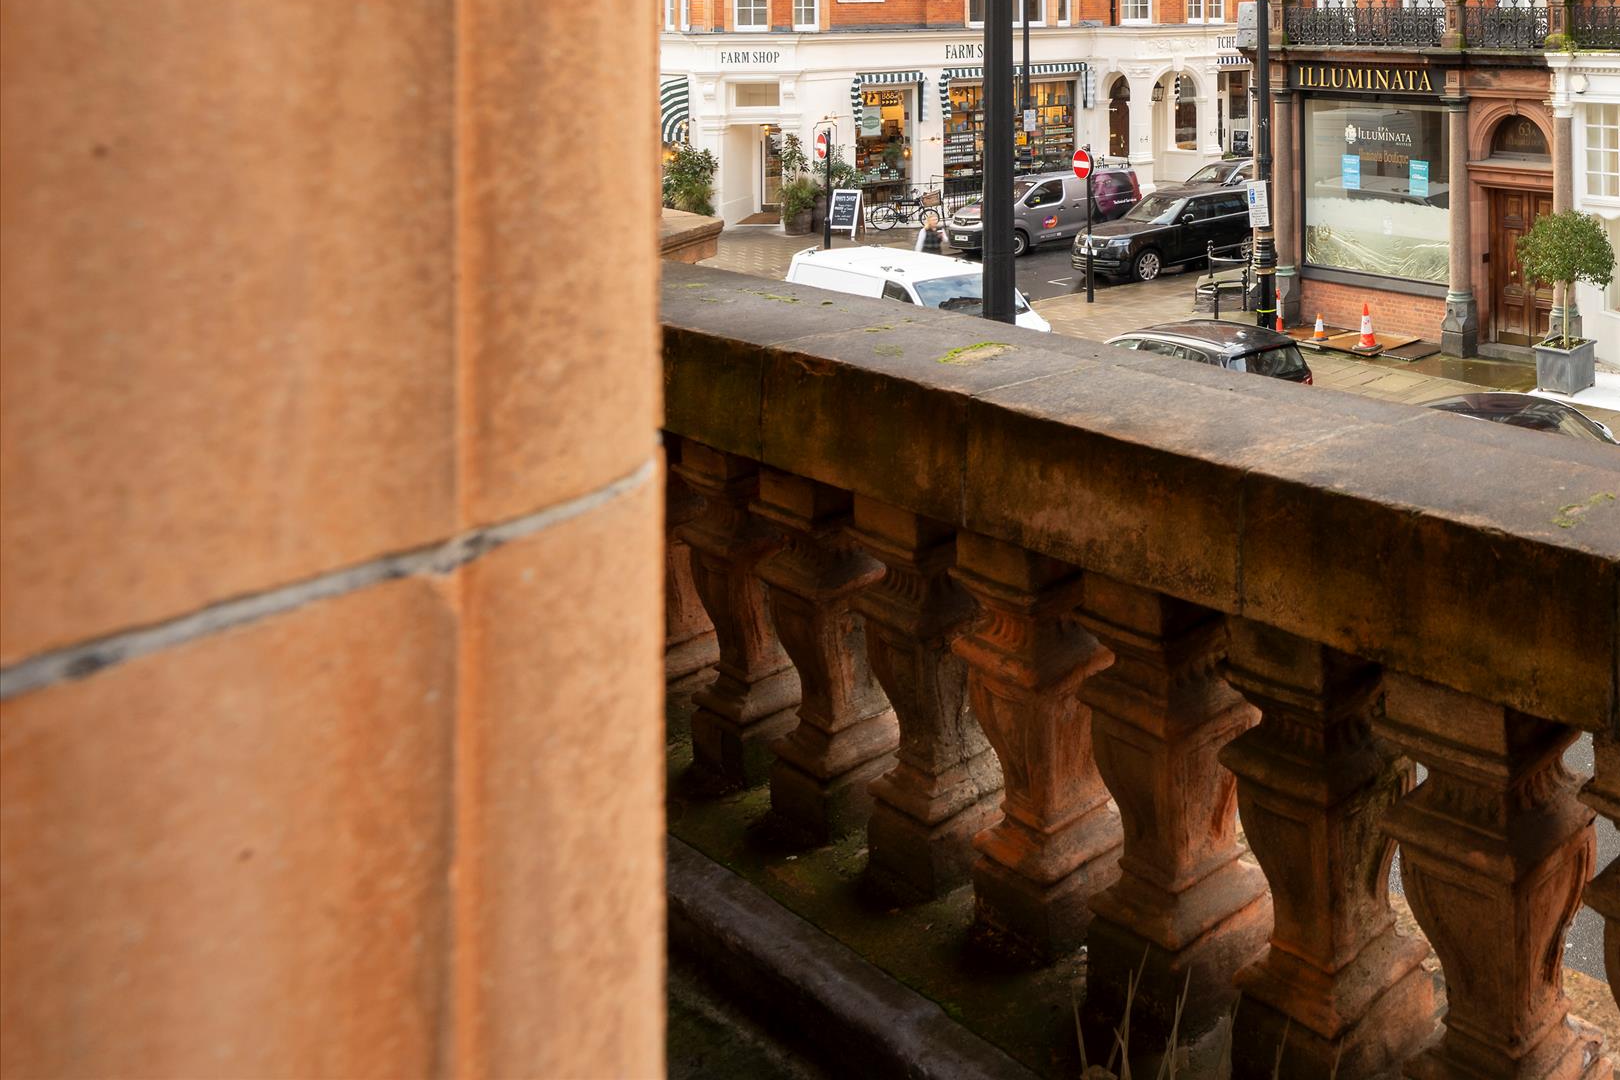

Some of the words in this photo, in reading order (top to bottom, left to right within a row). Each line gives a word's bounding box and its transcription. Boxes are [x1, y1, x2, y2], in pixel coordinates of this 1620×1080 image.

[721, 51, 749, 64] FARM
[752, 51, 780, 64] SHOP
[945, 44, 974, 59] FARM
[1299, 66, 1432, 91] ILLUMINATA
[1358, 126, 1412, 143] ILLUMINATA
